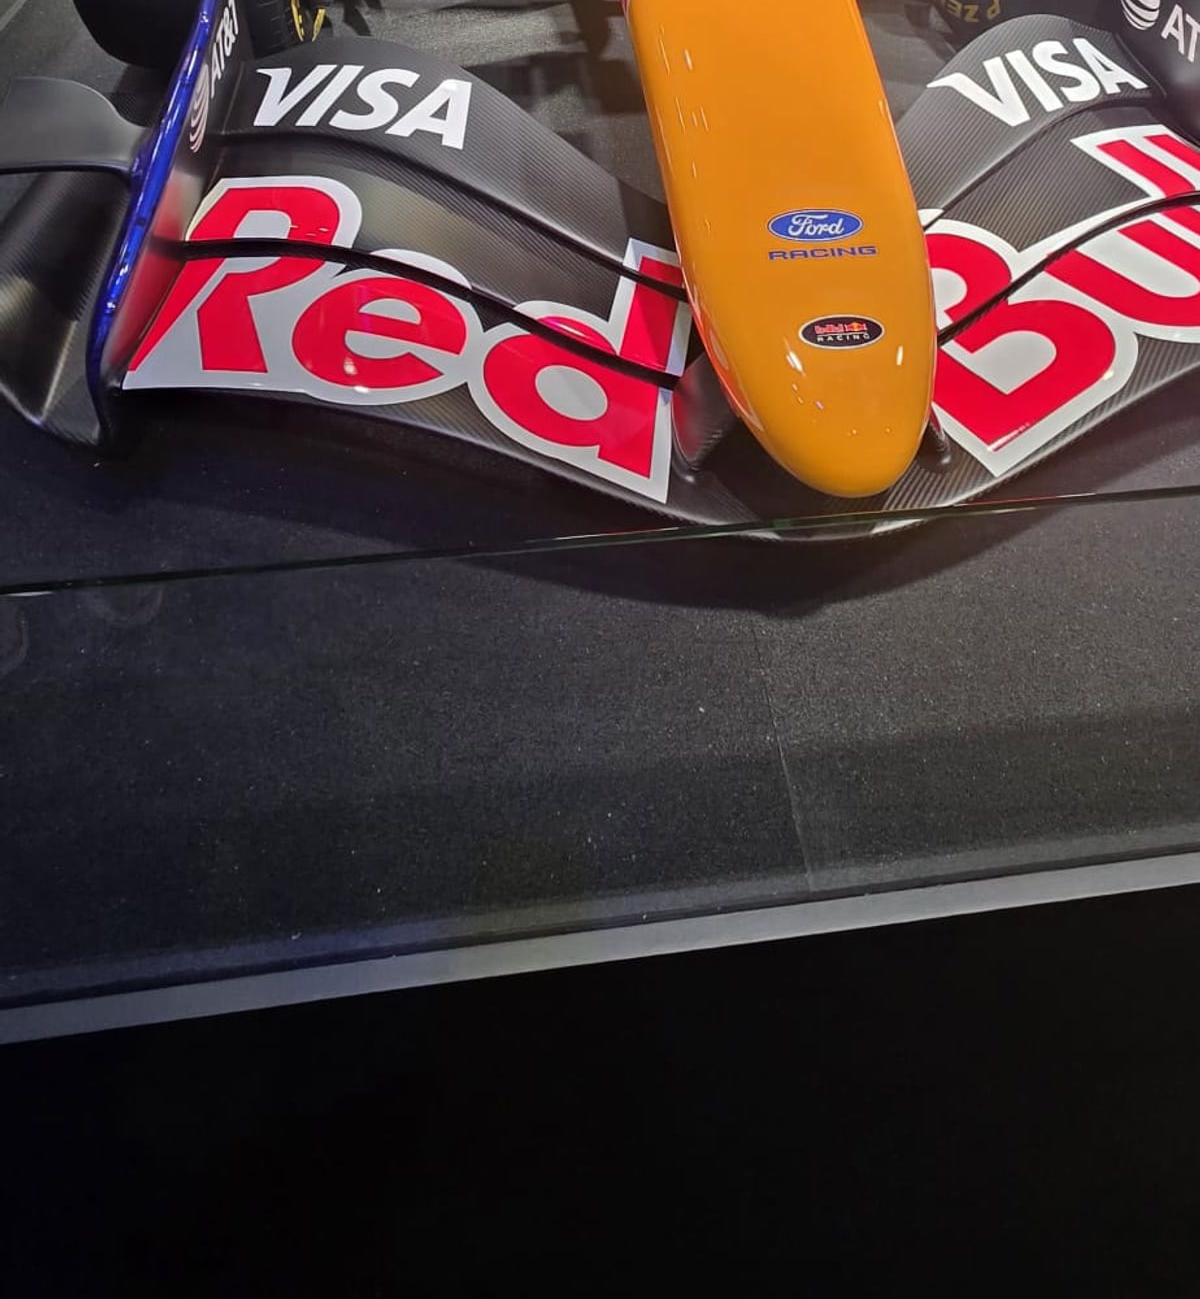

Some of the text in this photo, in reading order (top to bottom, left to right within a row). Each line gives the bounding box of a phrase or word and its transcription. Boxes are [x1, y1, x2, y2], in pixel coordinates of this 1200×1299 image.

[252, 64, 473, 150] VISA
[927, 37, 1149, 127] VISA
[788, 213, 845, 236] Ford
[768, 245, 877, 261] RACING
[124, 177, 692, 502] Red
[816, 333, 870, 343] RACING
